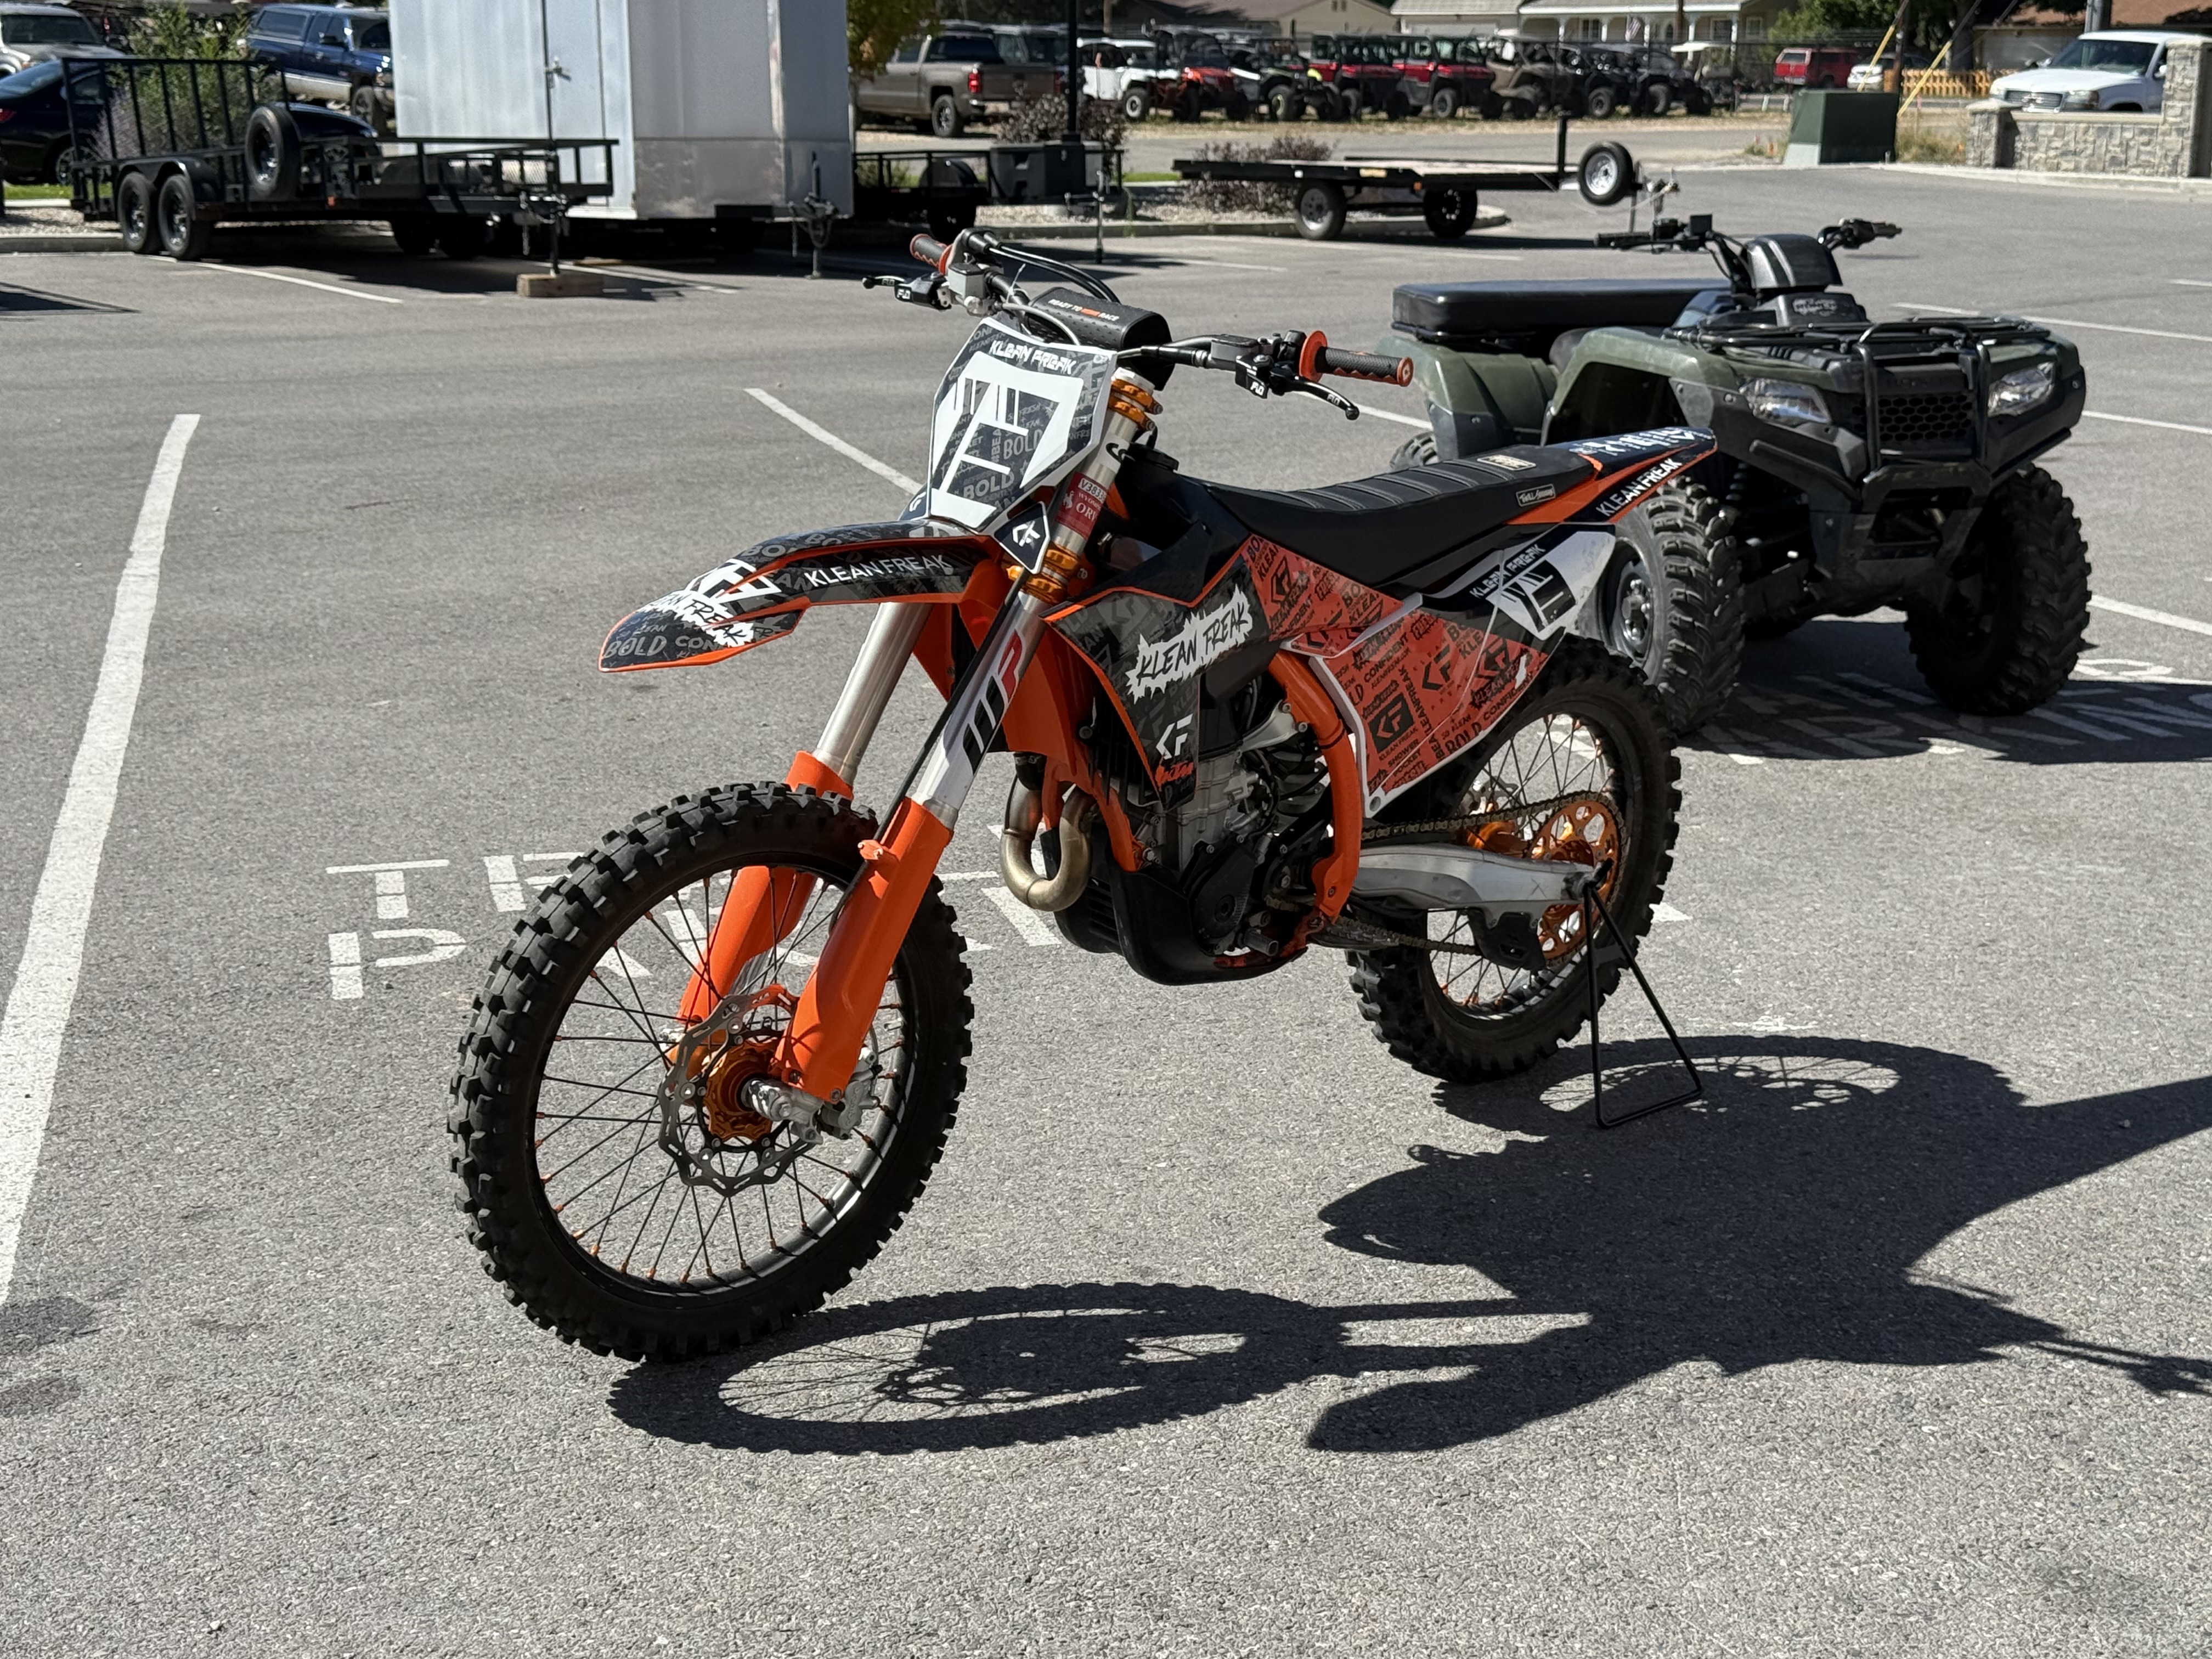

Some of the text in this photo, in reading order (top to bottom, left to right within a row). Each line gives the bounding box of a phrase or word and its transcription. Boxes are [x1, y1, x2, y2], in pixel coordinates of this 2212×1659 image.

[1098, 313, 1120, 321] RACE
[990, 340, 1032, 363] KLEAN
[1030, 349, 1076, 375] FREAK
[963, 469, 1014, 500] BOLD
[604, 635, 667, 658] BOLD
[1136, 629, 1197, 686] KLEAN
[1203, 602, 1249, 655] FREAK
[1387, 738, 1419, 767] SHOWER
